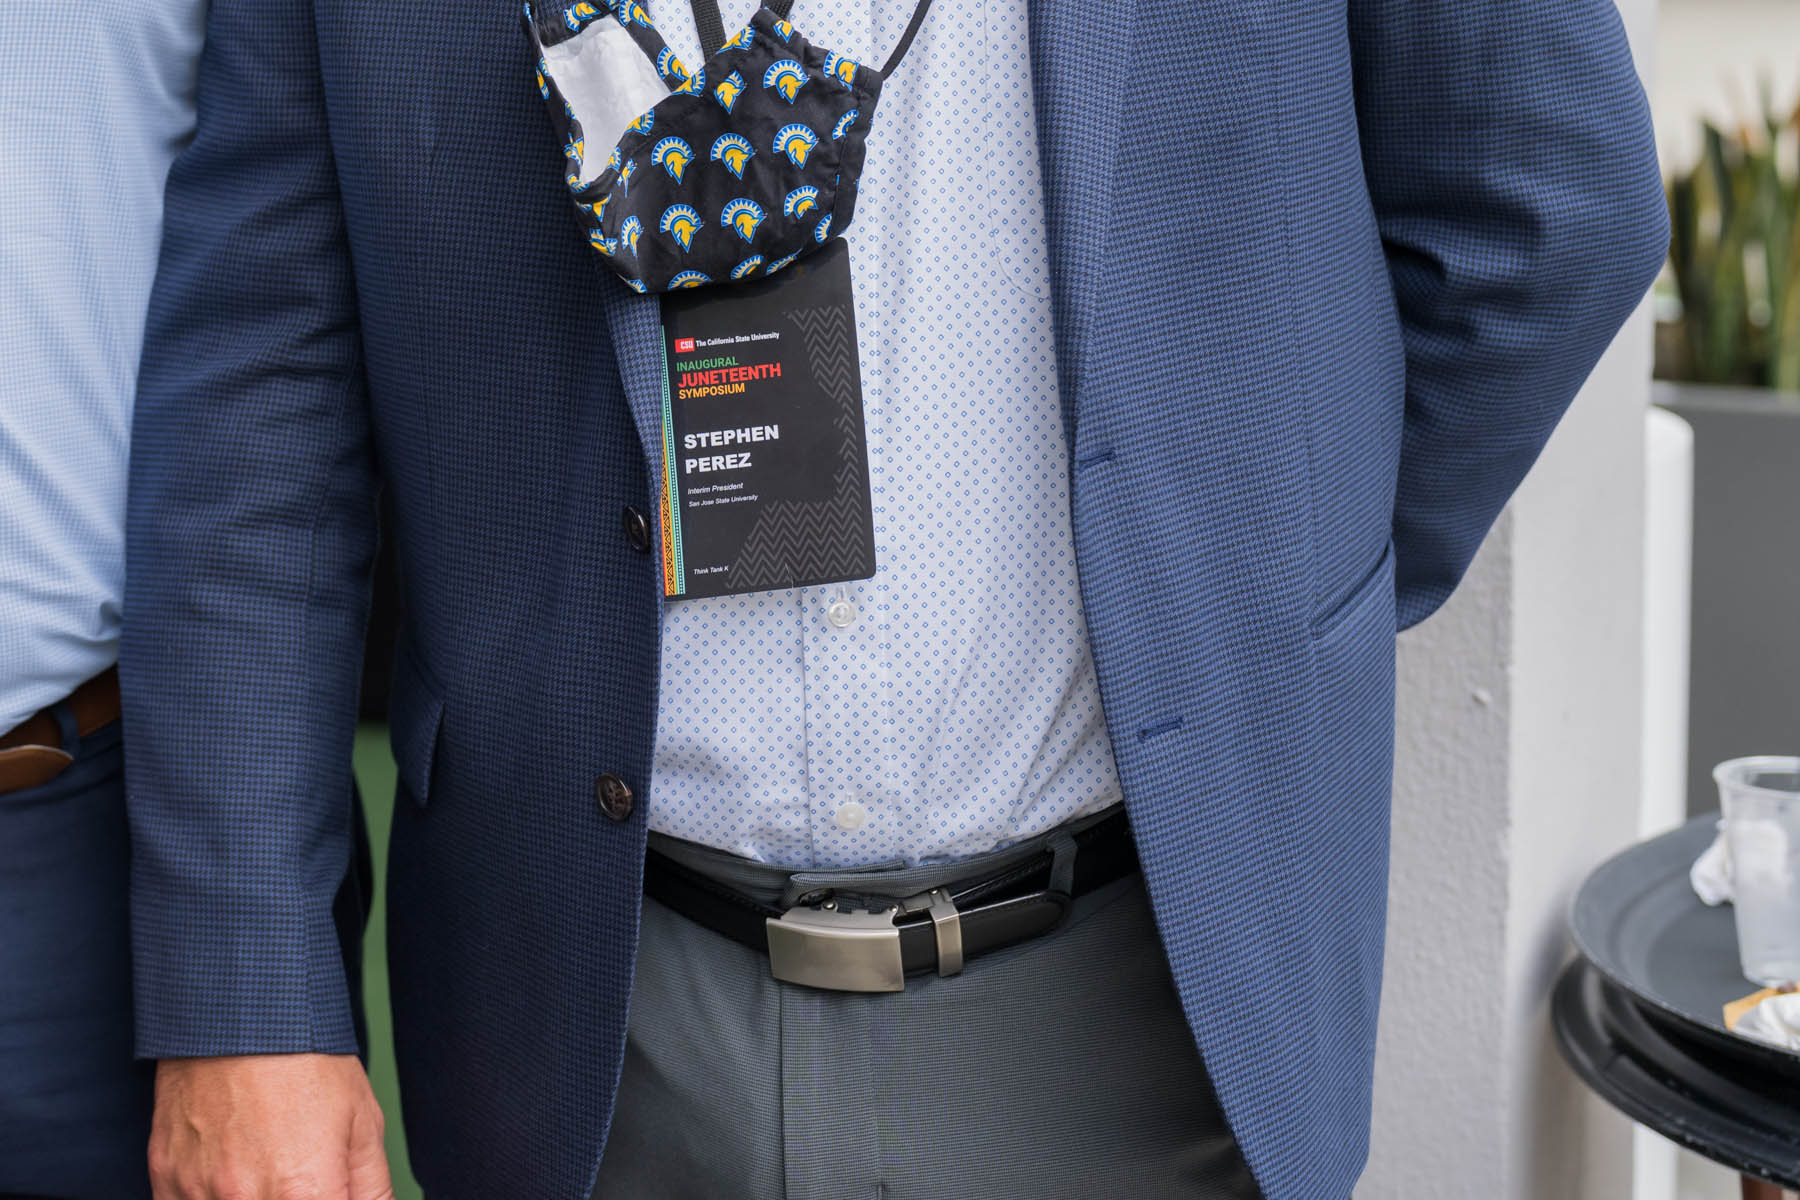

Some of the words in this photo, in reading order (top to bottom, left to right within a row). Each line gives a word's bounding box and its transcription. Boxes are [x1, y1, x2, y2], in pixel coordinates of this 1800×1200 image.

[680, 340, 693, 350] CSU
[696, 340, 707, 348] The
[707, 337, 734, 346] California
[735, 335, 750, 343] State
[751, 331, 780, 341] University
[677, 357, 739, 372] INAUGURAL
[678, 362, 782, 388] JUNETEENTH
[679, 383, 745, 400] SYMPOSIUM
[684, 424, 779, 449] STEPHEN
[685, 452, 752, 474] PEREZ
[687, 486, 711, 495] Interim
[712, 482, 744, 493] President
[715, 497, 730, 505] State
[731, 494, 758, 503] University
[694, 567, 709, 575] Think
